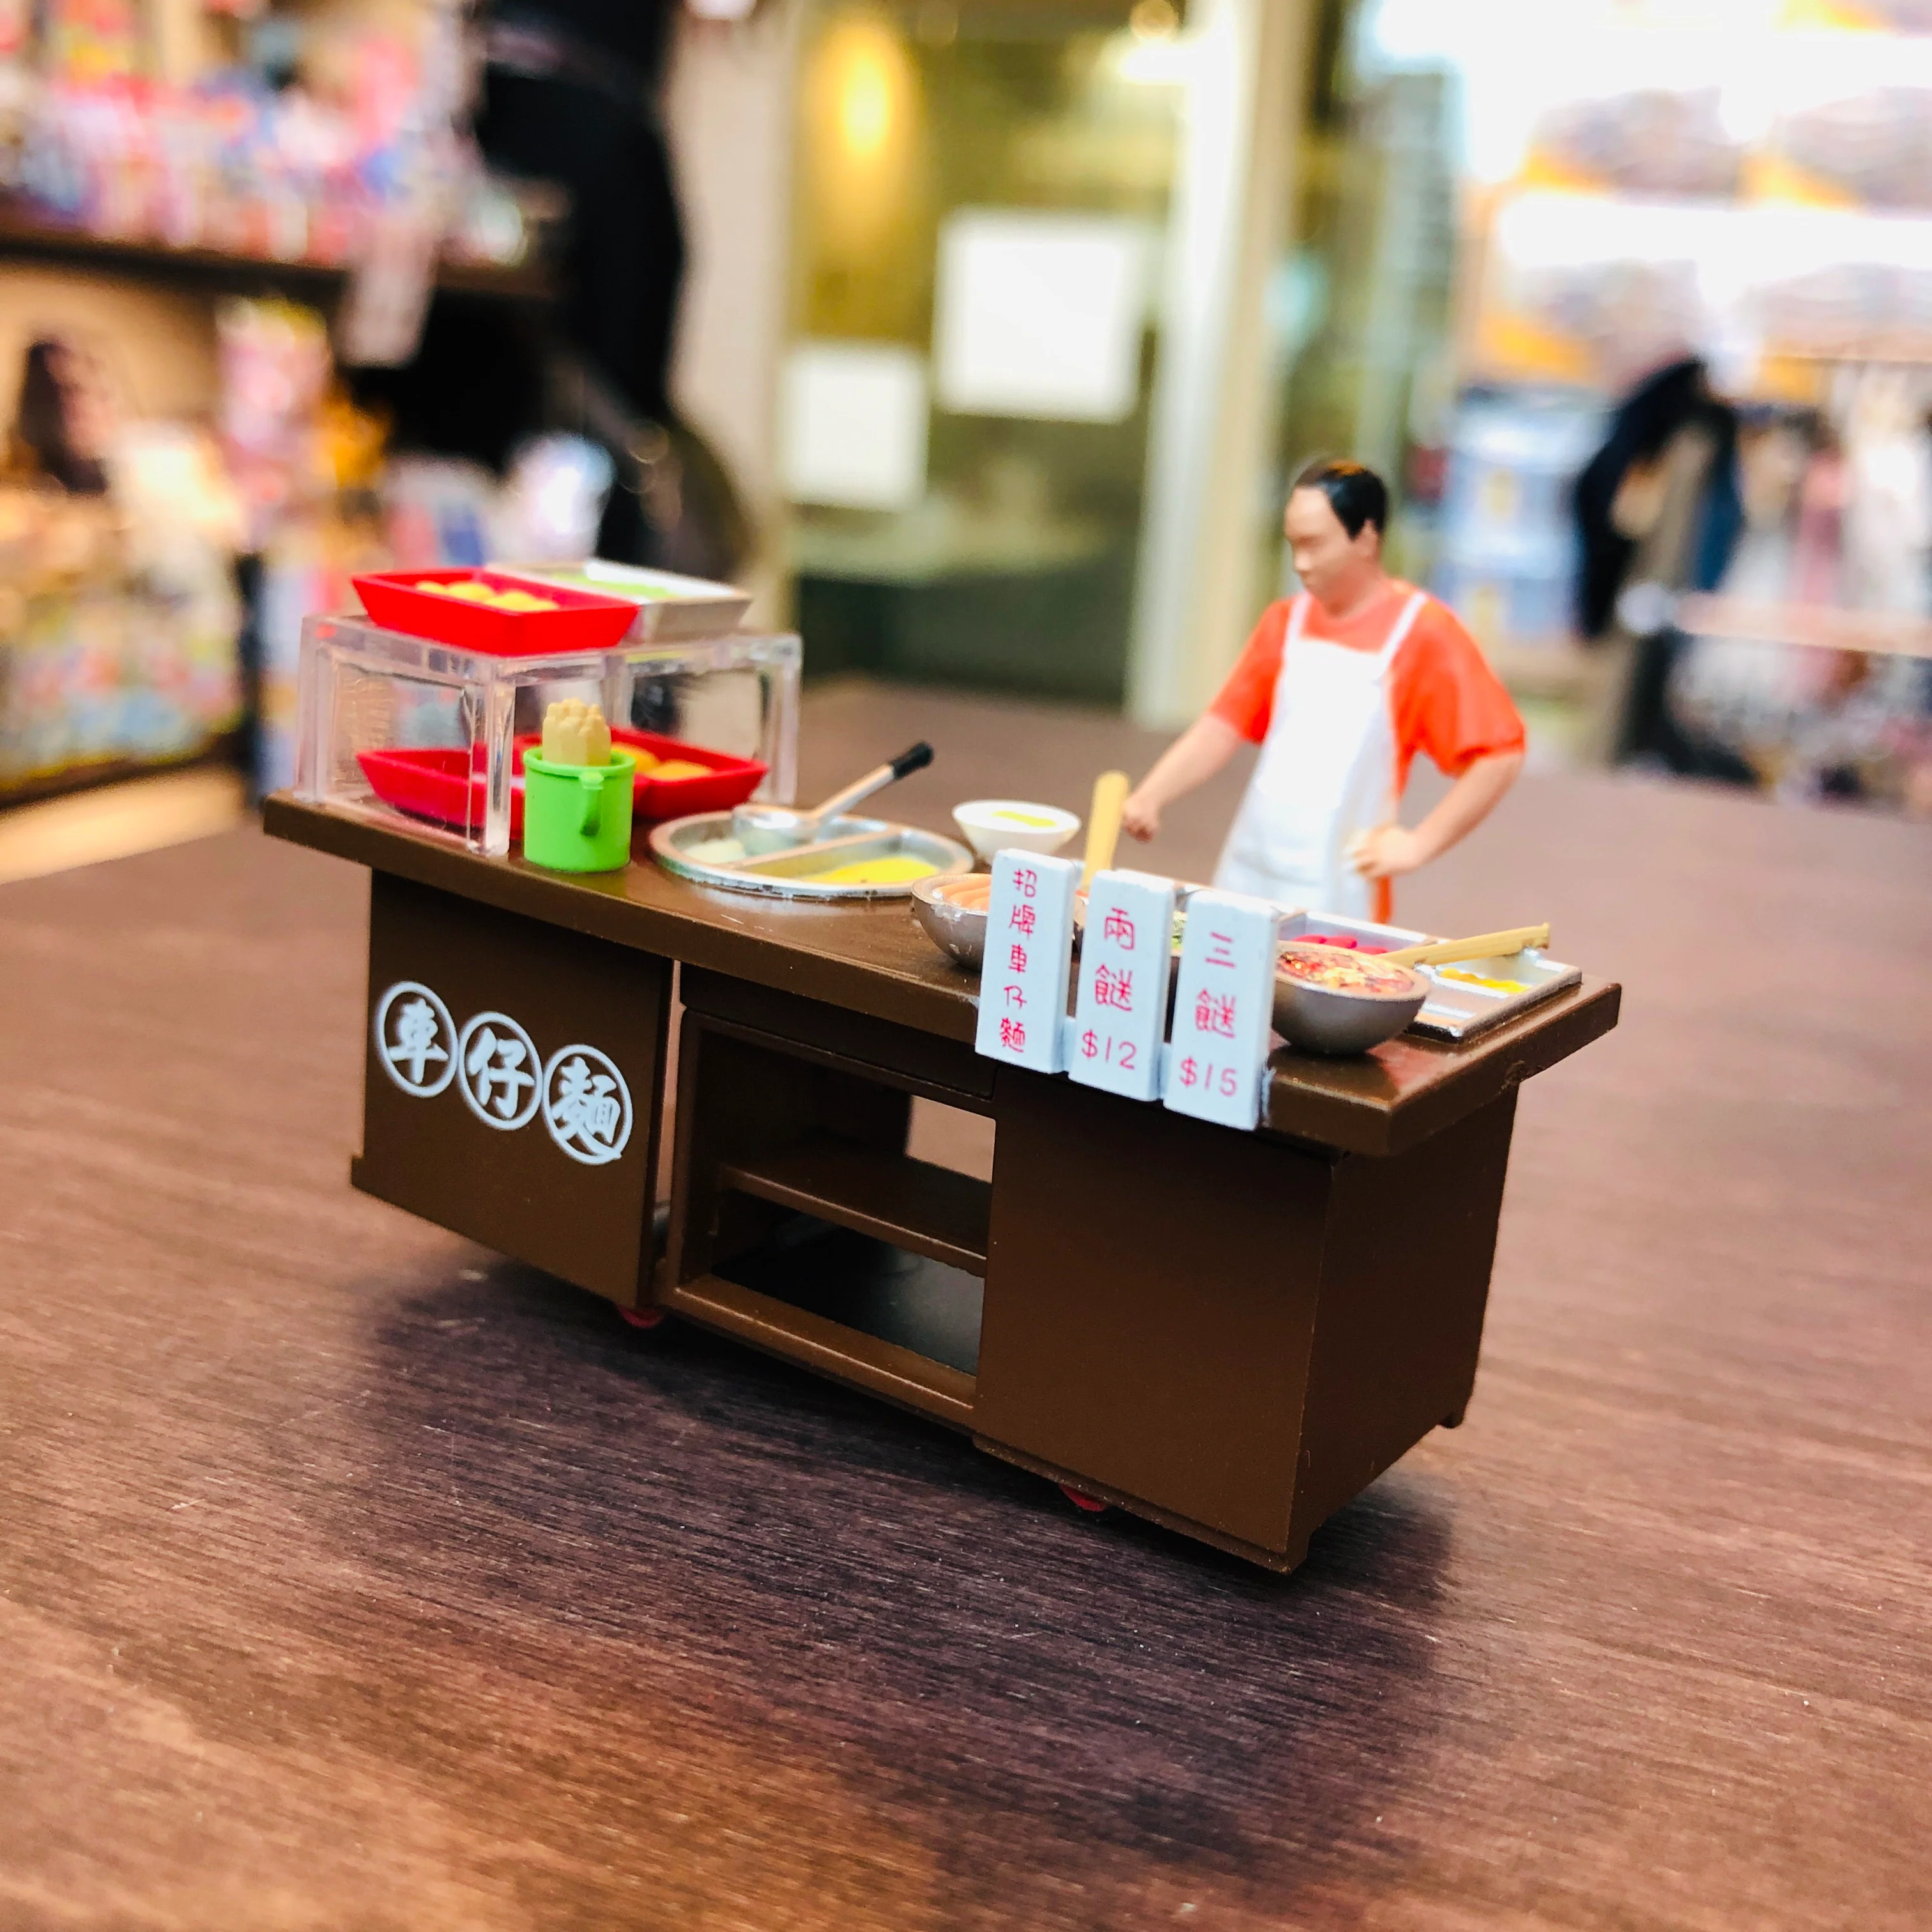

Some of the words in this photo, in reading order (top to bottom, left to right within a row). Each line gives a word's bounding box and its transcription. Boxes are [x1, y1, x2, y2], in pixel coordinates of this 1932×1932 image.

[1000, 869, 1038, 1054] 招牌車仔麵
[387, 997, 622, 1158] 車仔麵
[1082, 1029, 1137, 1071] $12
[1179, 1056, 1238, 1096] $15
